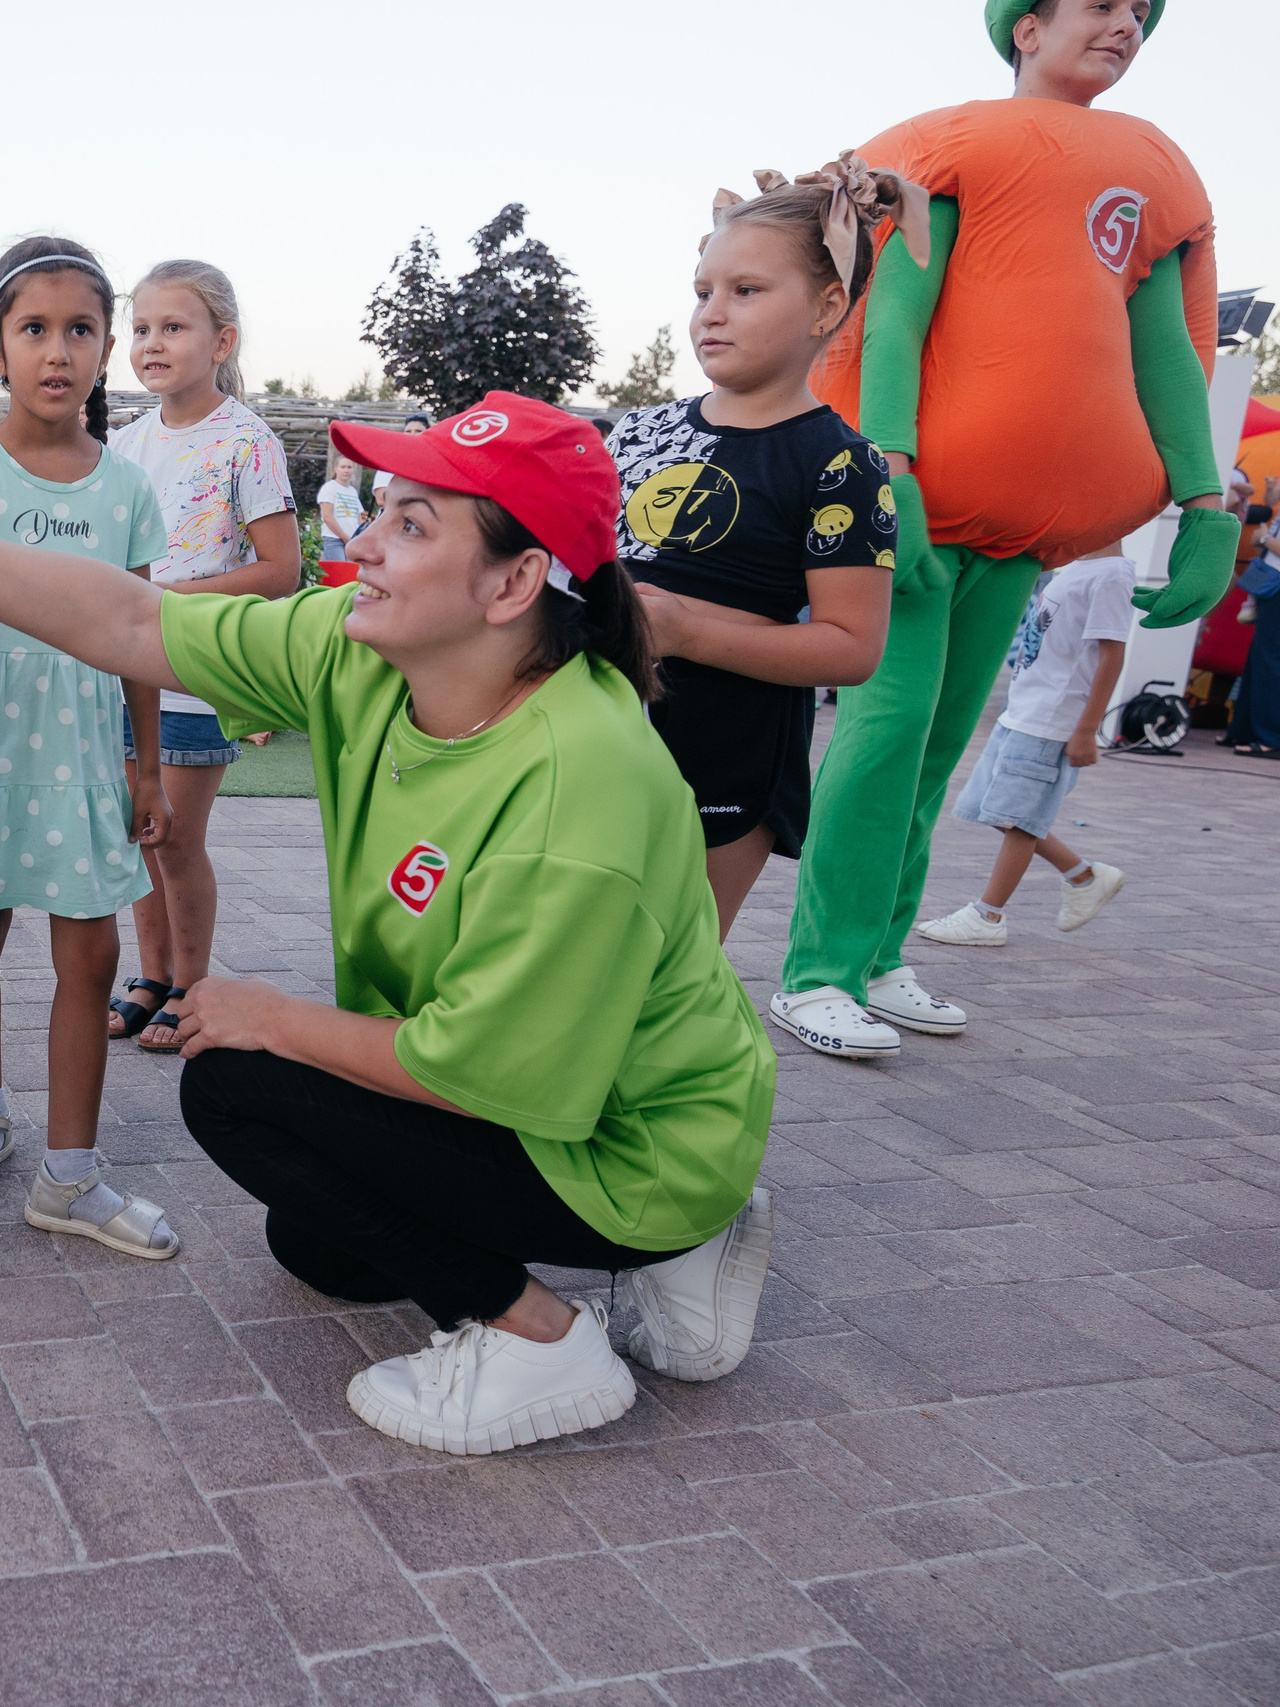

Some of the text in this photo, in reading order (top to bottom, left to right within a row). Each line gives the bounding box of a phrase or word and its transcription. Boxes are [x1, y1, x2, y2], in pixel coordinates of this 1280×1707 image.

[1100, 203, 1136, 255] 5
[12, 508, 93, 545] Dream
[400, 851, 446, 901] 5
[798, 1026, 842, 1049] crocs
